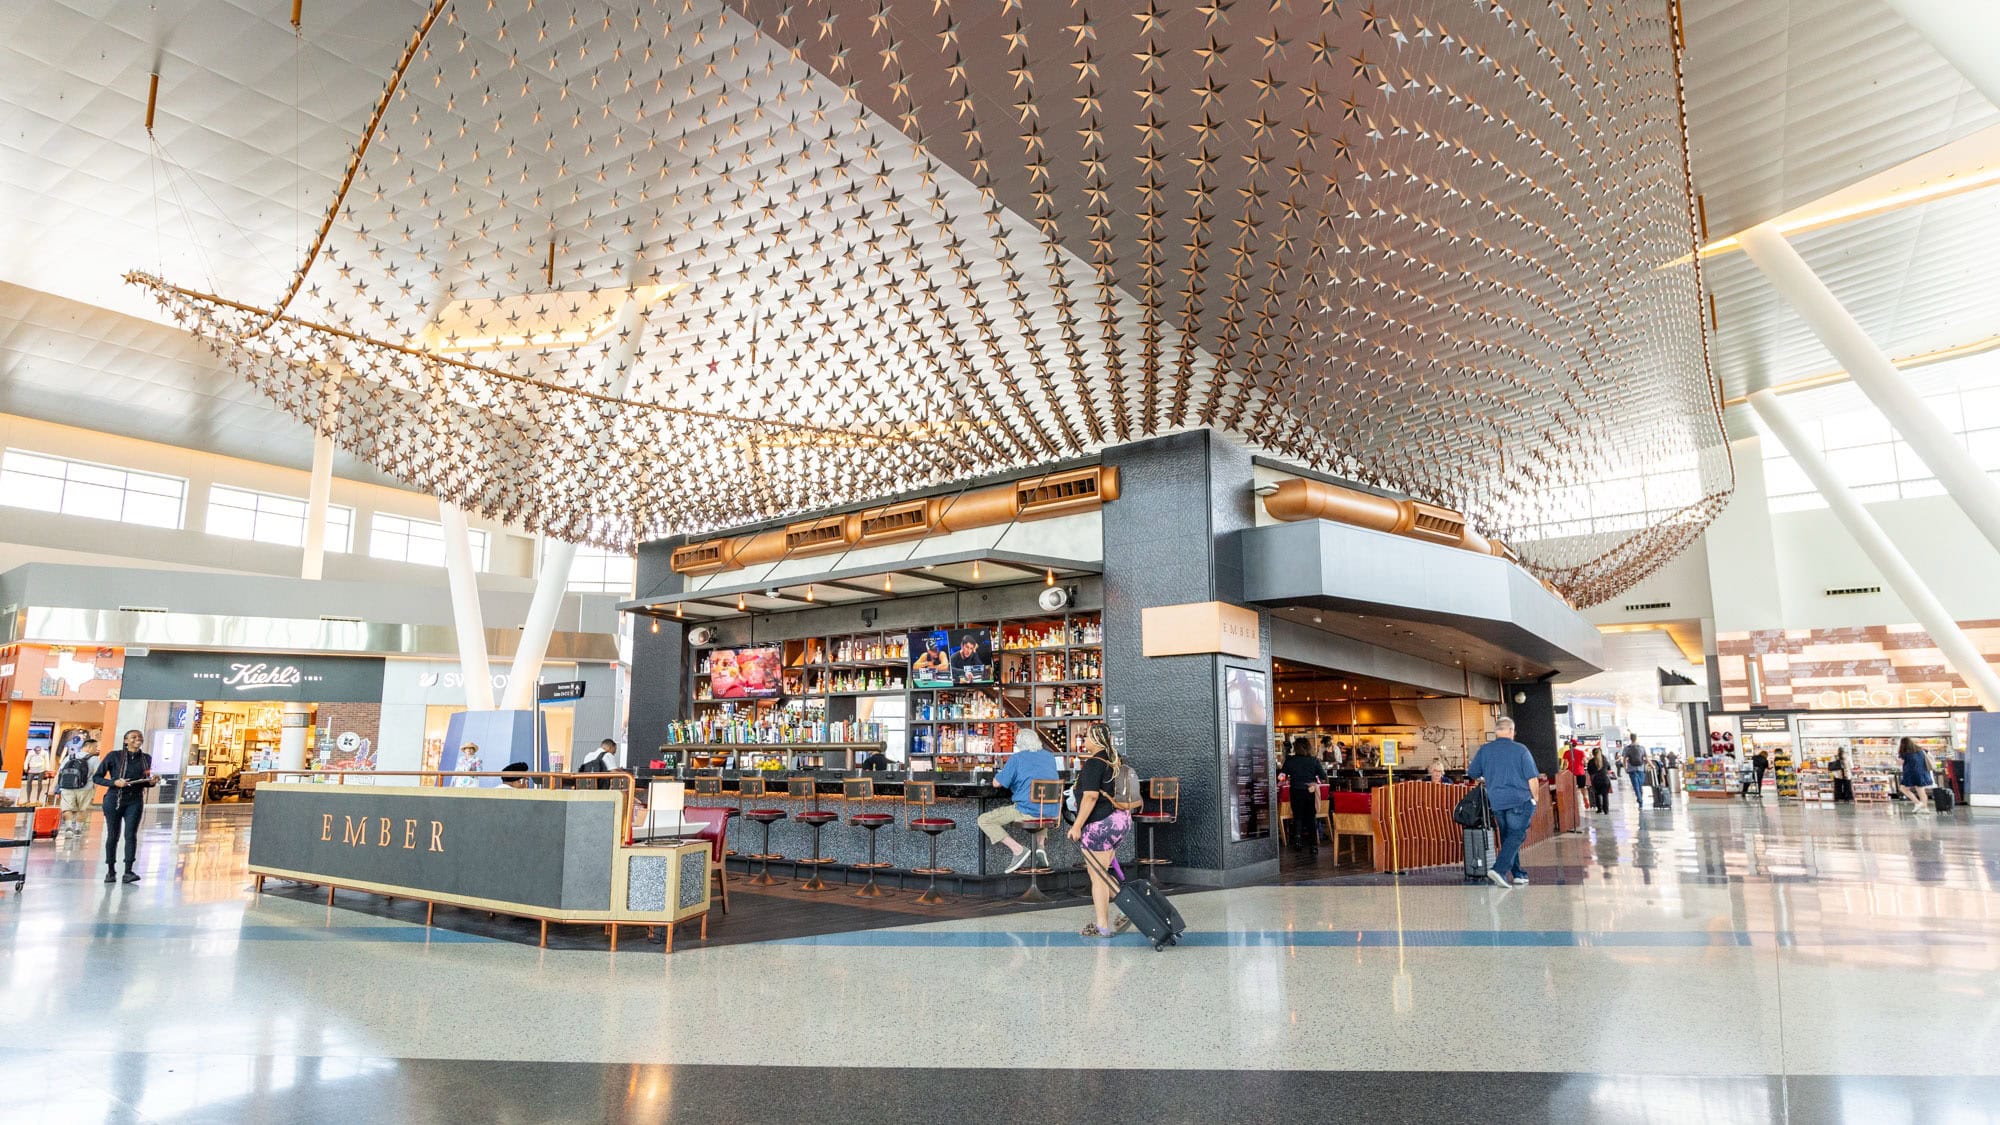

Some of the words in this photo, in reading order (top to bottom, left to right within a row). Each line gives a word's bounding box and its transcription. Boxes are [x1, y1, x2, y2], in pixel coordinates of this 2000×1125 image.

[1223, 621, 1256, 639] EMBER
[223, 663, 300, 685] Kiehl's
[1819, 689, 1893, 708] CIBO
[1905, 688, 1980, 707] EXP
[320, 813, 445, 852] EMBER
